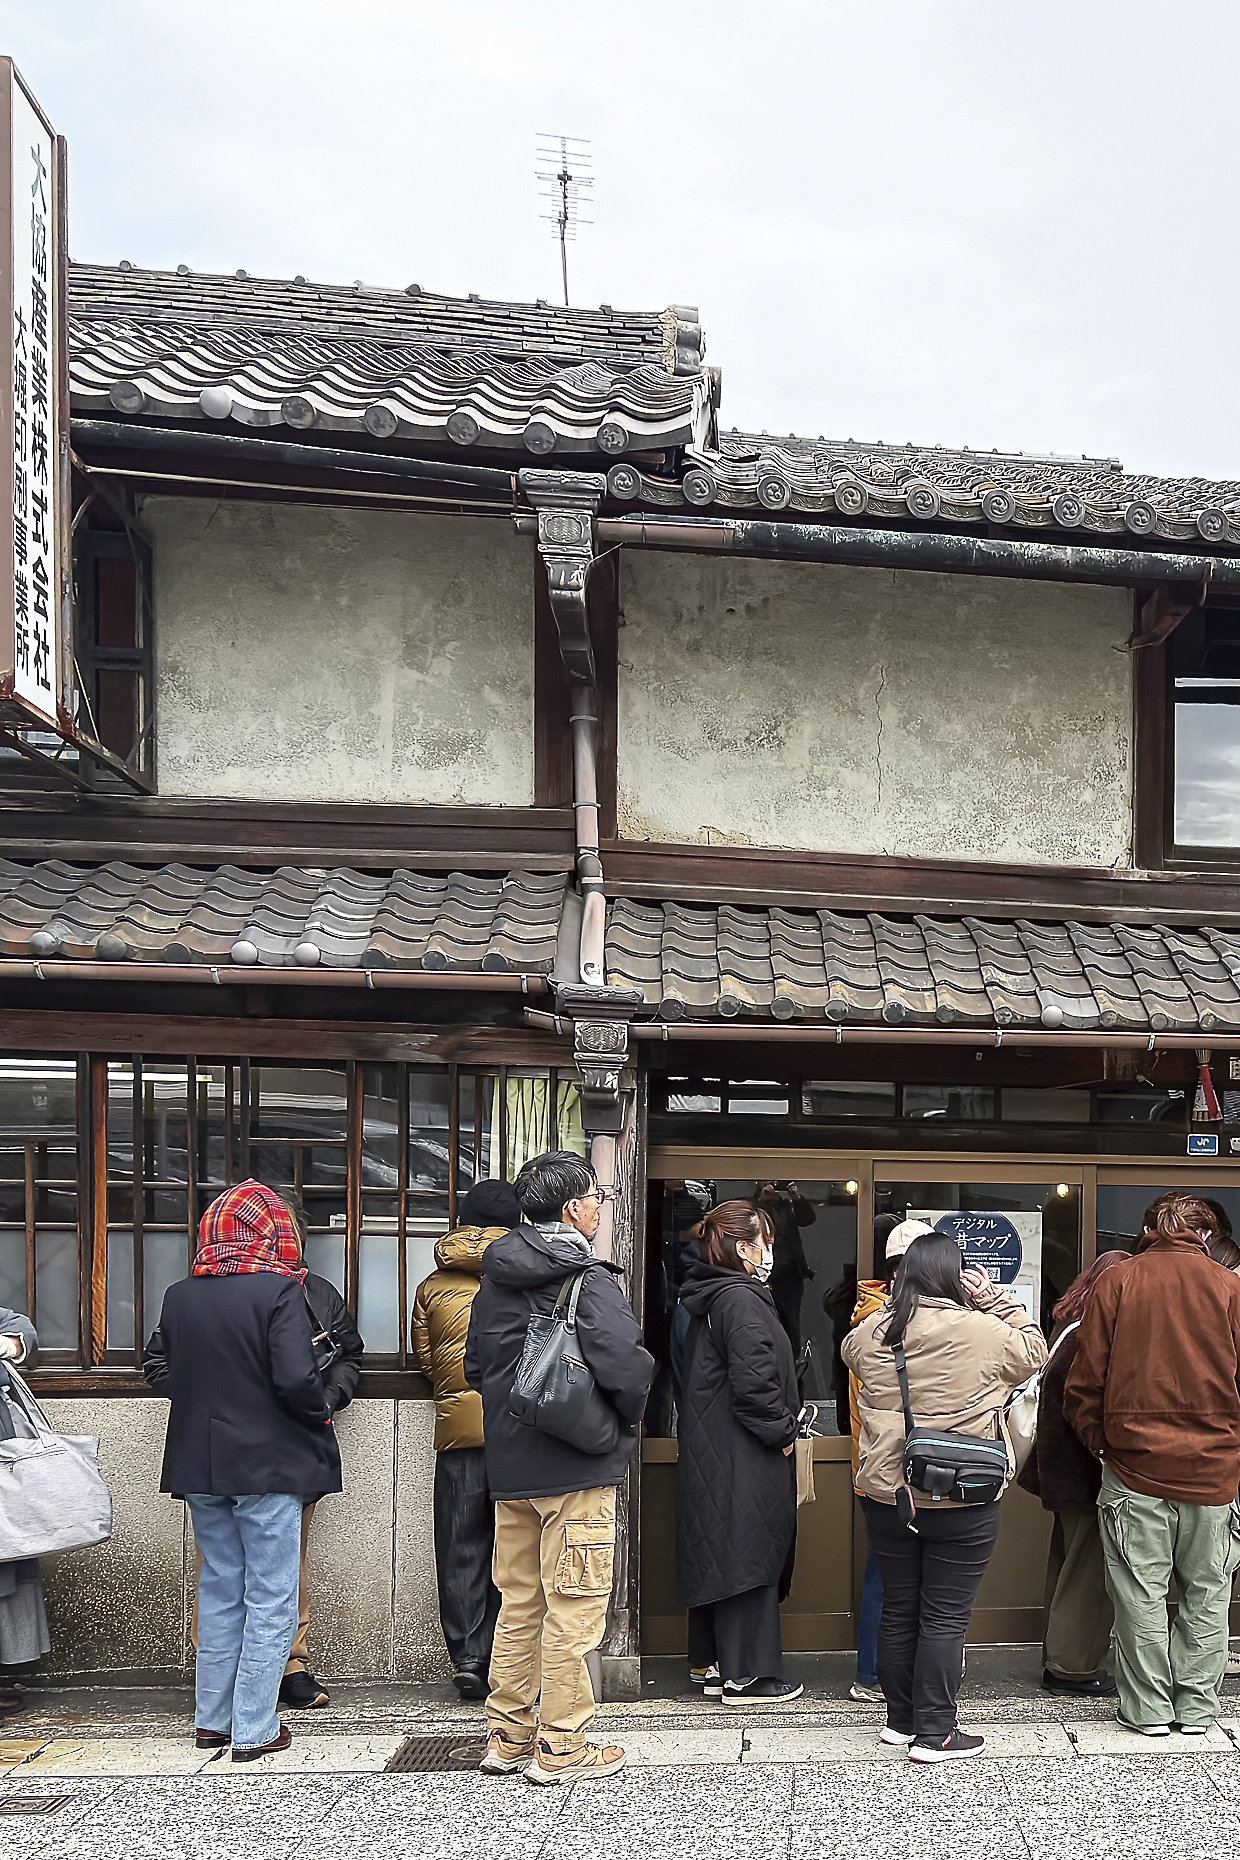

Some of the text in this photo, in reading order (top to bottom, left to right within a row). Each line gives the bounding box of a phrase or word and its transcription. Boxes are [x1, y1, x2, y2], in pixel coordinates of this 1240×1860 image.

[30, 143, 51, 692] 大協産業株式会社
[952, 1217, 998, 1230] デジタル
[943, 1231, 1012, 1250] 昔マップ
